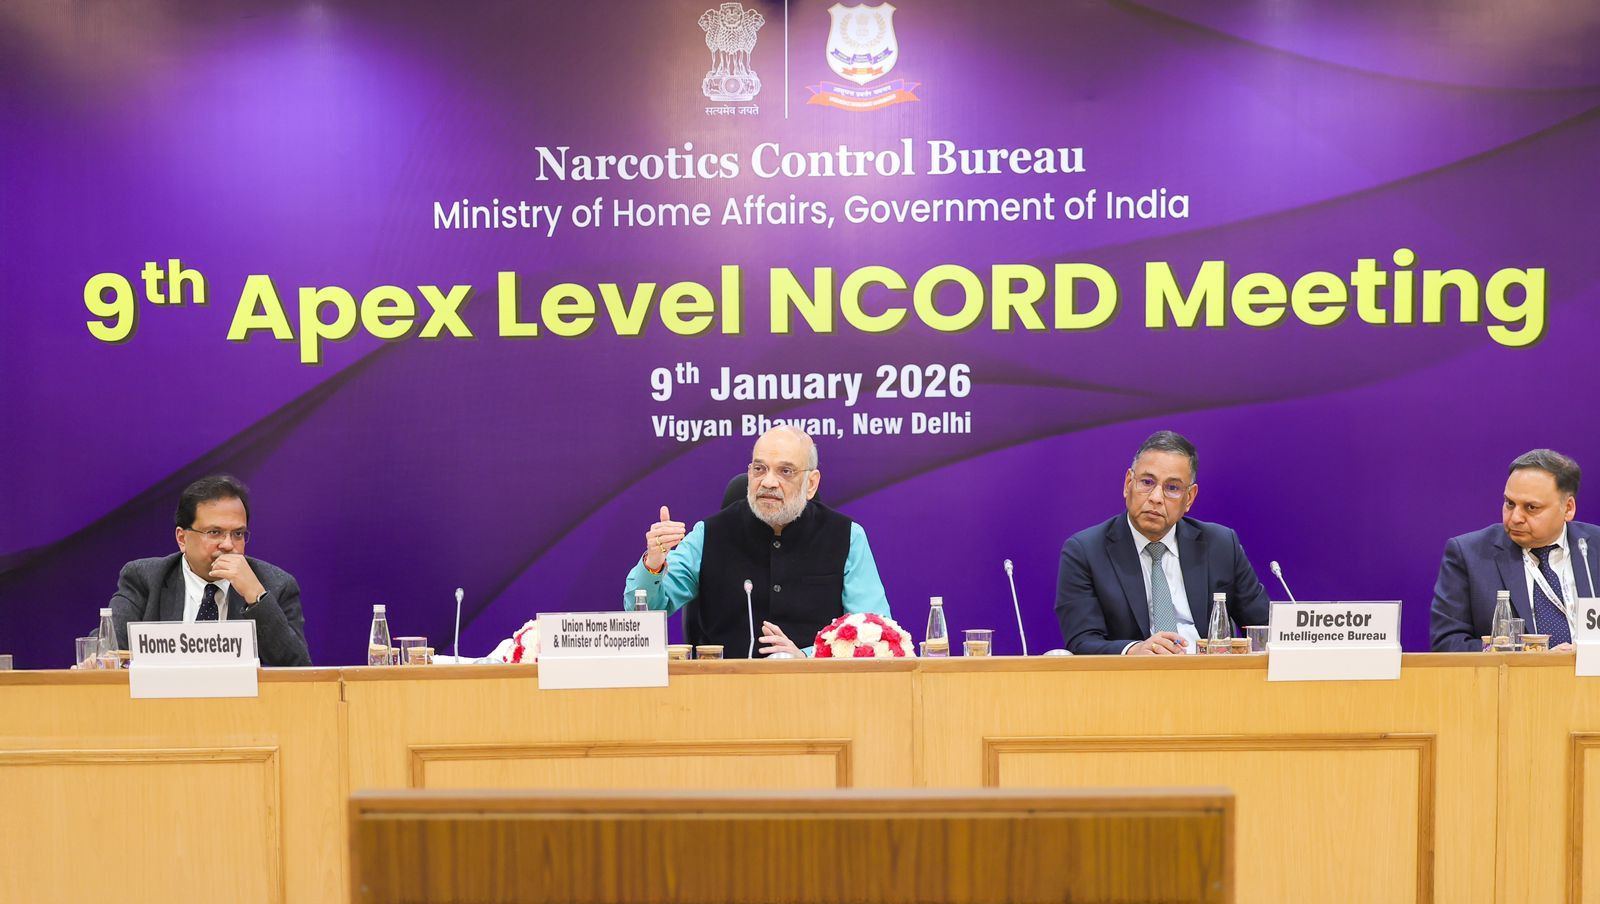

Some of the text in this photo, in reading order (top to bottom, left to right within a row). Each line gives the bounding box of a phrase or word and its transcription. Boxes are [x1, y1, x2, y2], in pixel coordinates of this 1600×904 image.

[704, 104, 760, 116] सत्यमेव जयते
[535, 137, 1086, 181] Narcotics Control Bureau
[433, 188, 1190, 237] Ministry of Home Affairs, Government of India
[83, 248, 1546, 364] 9th Apex Level NCORD Meeting
[650, 361, 972, 406] 9th January 2026
[651, 415, 732, 442] Vigyan
[852, 413, 903, 435] New
[911, 411, 972, 434] Delhi
[561, 618, 641, 632] Union Home Minister
[1296, 609, 1372, 627] Director
[138, 632, 243, 658] Home Secretary
[553, 634, 650, 650] & Minister of Cooperation
[1279, 630, 1387, 643] Intelligence Bureau
